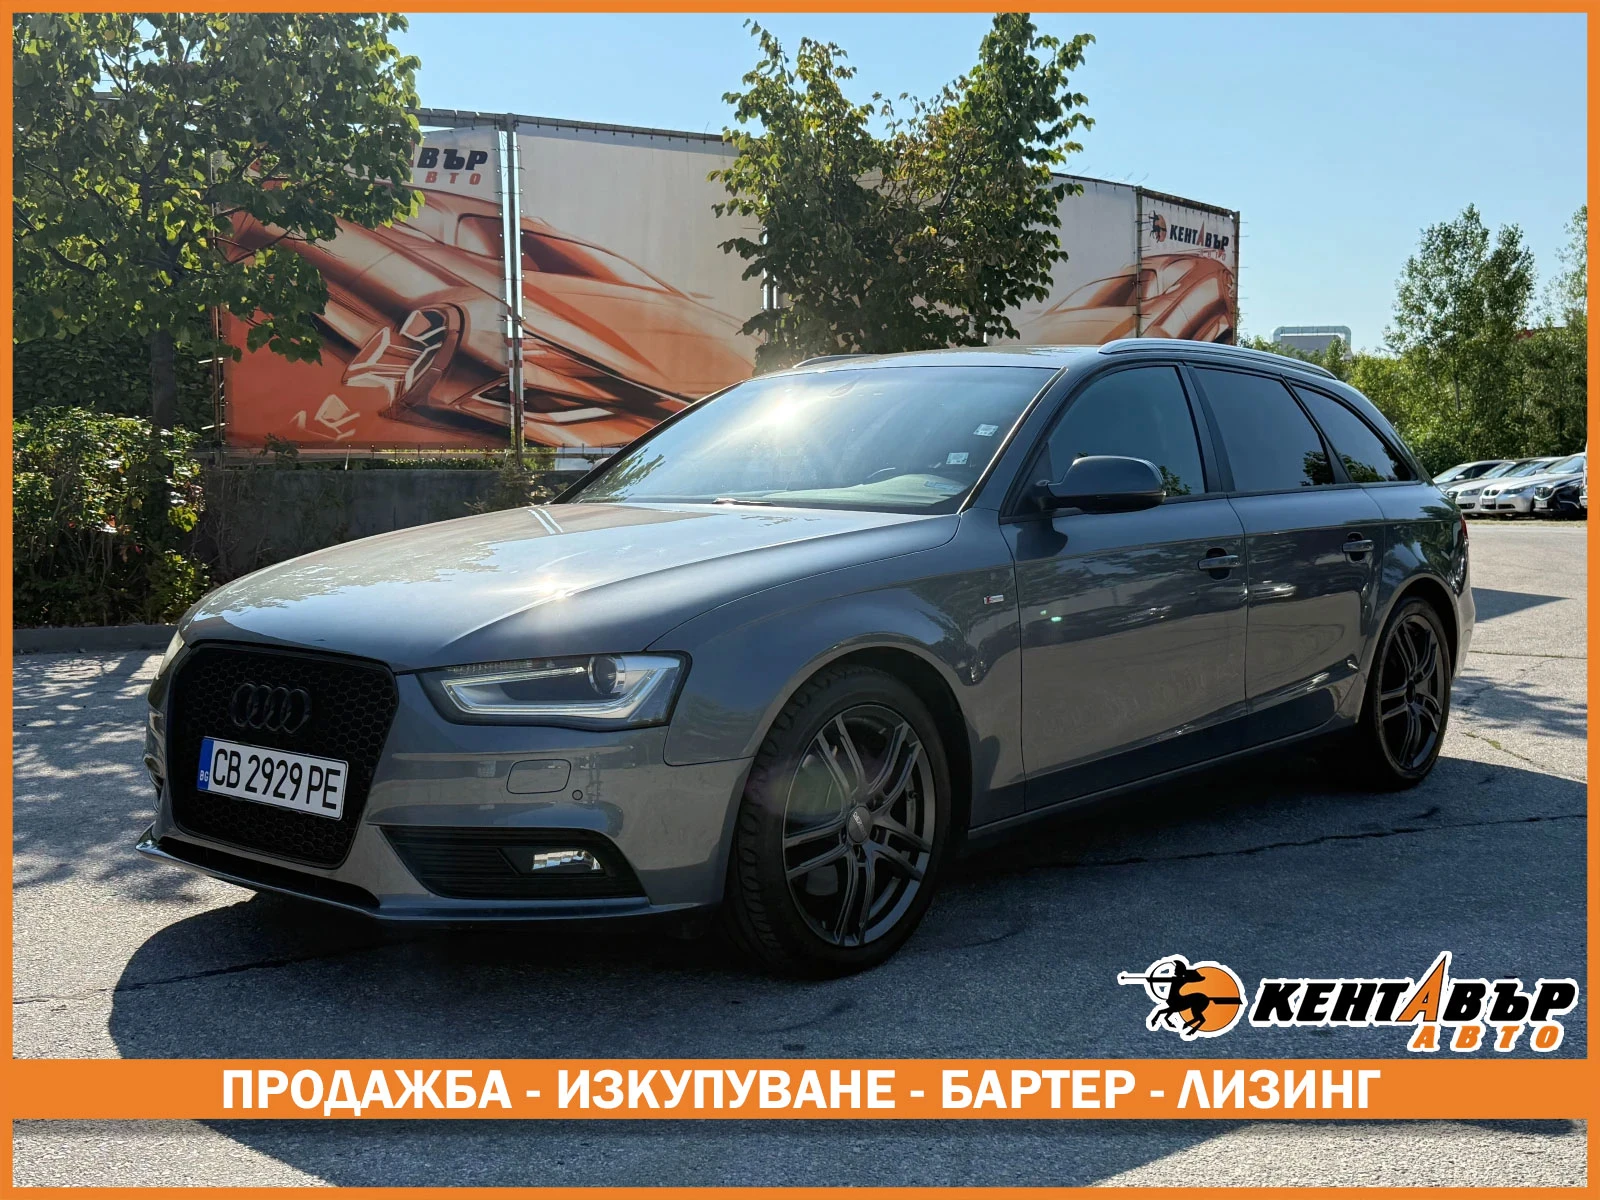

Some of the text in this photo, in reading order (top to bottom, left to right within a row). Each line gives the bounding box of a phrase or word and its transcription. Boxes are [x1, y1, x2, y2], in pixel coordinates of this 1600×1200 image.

[411, 146, 488, 171] ВЪР
[424, 171, 482, 185] ВТО
[1170, 221, 1230, 250] КЕНТАВЪР
[245, 754, 303, 802] 2929
